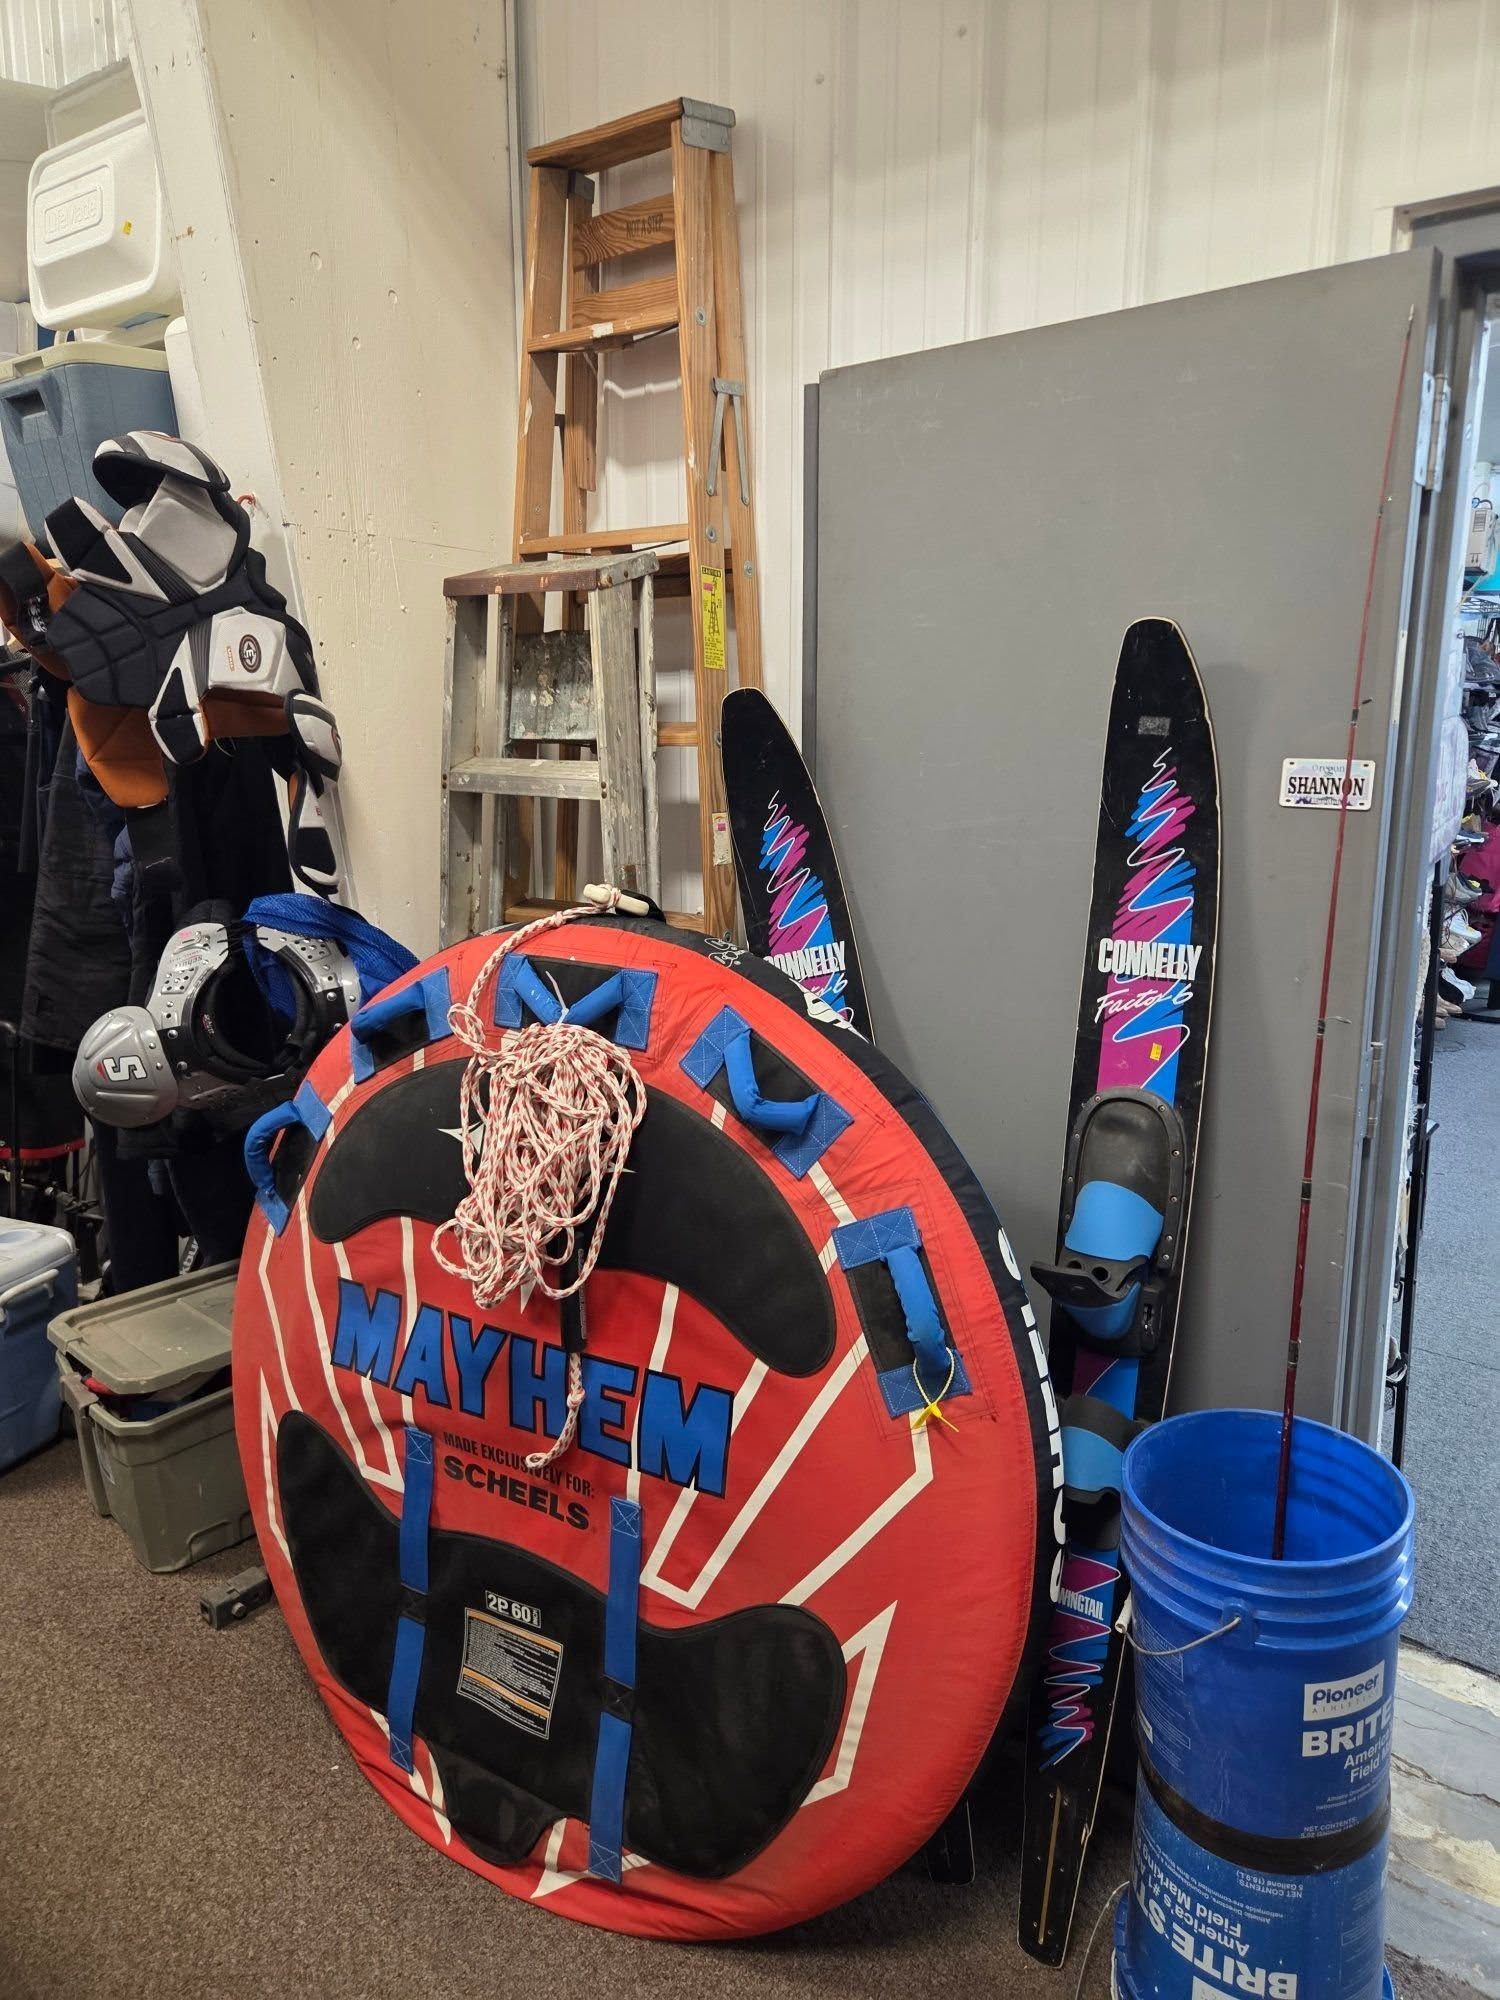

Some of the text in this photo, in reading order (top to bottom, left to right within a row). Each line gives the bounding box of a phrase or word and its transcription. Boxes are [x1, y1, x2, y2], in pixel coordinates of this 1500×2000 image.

[626, 219, 641, 240] NOT
[647, 213, 664, 234] STEP
[763, 941, 845, 980] ONNELLY
[1098, 938, 1202, 980] CONNELLY
[1094, 983, 1193, 1024] Factor 6
[330, 1276, 735, 1498] MAYHEM
[443, 1431, 479, 1456] MADE
[563, 1471, 596, 1499] FOR:
[443, 1456, 590, 1532] SCHEELS
[511, 1602, 532, 1623] 60
[1312, 1673, 1379, 1705] Pioneer
[1302, 1695, 1394, 1757] BRITE
[1350, 1754, 1380, 1783] Field
[1142, 1843, 1190, 1910] Marking
[1267, 1880, 1297, 1890] Gallons
[1286, 1890, 1303, 1898] NET
[1163, 1893, 1249, 1957] America's
[1195, 1902, 1241, 1938] Field
[1171, 1922, 1297, 2000] BRITE
